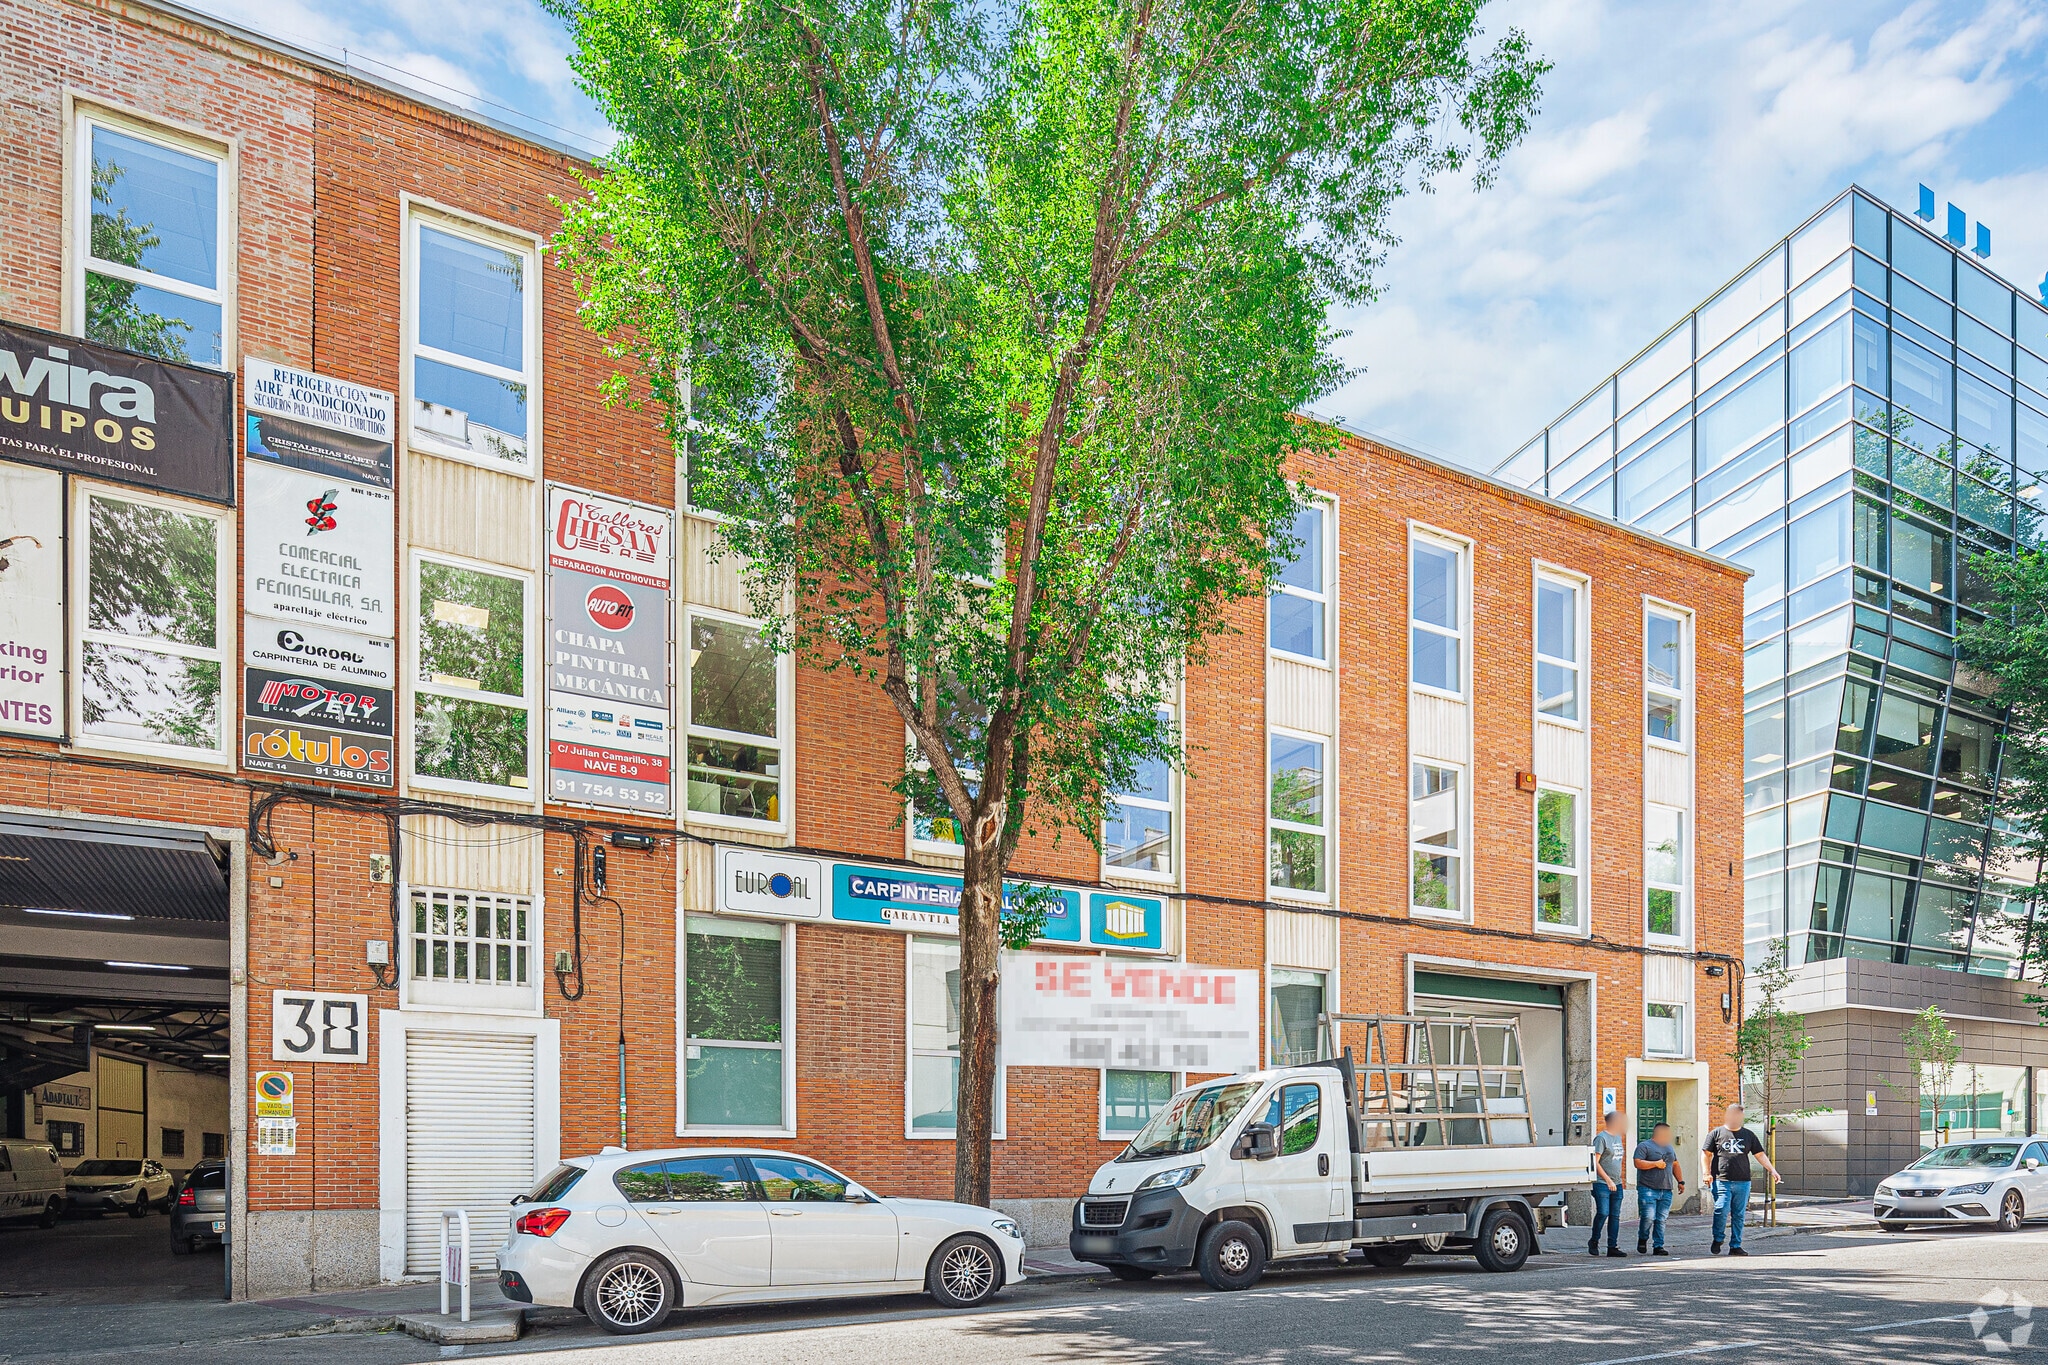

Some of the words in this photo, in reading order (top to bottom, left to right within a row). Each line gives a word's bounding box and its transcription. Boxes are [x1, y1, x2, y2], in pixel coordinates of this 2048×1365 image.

[273, 368, 368, 403] REFRIGERACION
[253, 392, 291, 411] SECADEROS
[293, 402, 310, 418] PARA
[311, 406, 342, 424] JAMONES
[343, 414, 347, 426] Y
[349, 416, 386, 436] EMBUTIDOS
[254, 379, 284, 397] AIRE
[289, 387, 386, 422] ACONDICIONADO
[0, 436, 23, 448] TAS
[25, 442, 57, 455] PARA
[59, 448, 75, 459] EL
[76, 452, 158, 476] PROFESIONAL
[267, 436, 342, 458] CRISTALERIAS
[361, 472, 381, 482] NAVE
[556, 499, 660, 554] CHESAN
[585, 504, 663, 535] Talleres
[279, 543, 362, 571] COMERCIAL
[552, 558, 607, 576] REPARACIÓN
[608, 570, 667, 588] AUTOMOVILES
[273, 602, 322, 618] aparellaje
[326, 611, 368, 626] eléctrico
[555, 629, 625, 655] CHAPA
[252, 650, 319, 667] CARPINTERIA
[323, 662, 336, 670] DE
[341, 665, 387, 678] ALUMINIO
[555, 650, 650, 681] PINTURA
[276, 682, 376, 709] MOTOR
[555, 672, 664, 704] MECÁNICA
[556, 707, 577, 716] Allianz
[247, 729, 391, 772] rótulos
[557, 744, 568, 753] C/
[570, 746, 600, 758] Julian
[601, 751, 649, 767] Camarillo,
[651, 758, 663, 768] 38
[248, 759, 274, 768] NAVE
[315, 766, 330, 776] 91
[333, 768, 354, 779] 368
[356, 772, 370, 781] 01
[373, 774, 387, 783] 31
[584, 759, 617, 772] NAVE
[620, 764, 638, 776] 8-9
[555, 780, 575, 792] 91
[582, 782, 614, 798] 754
[620, 788, 639, 801] 53
[644, 791, 665, 805] 52
[883, 907, 950, 925] GARANTIA
[283, 997, 359, 1056] 38
